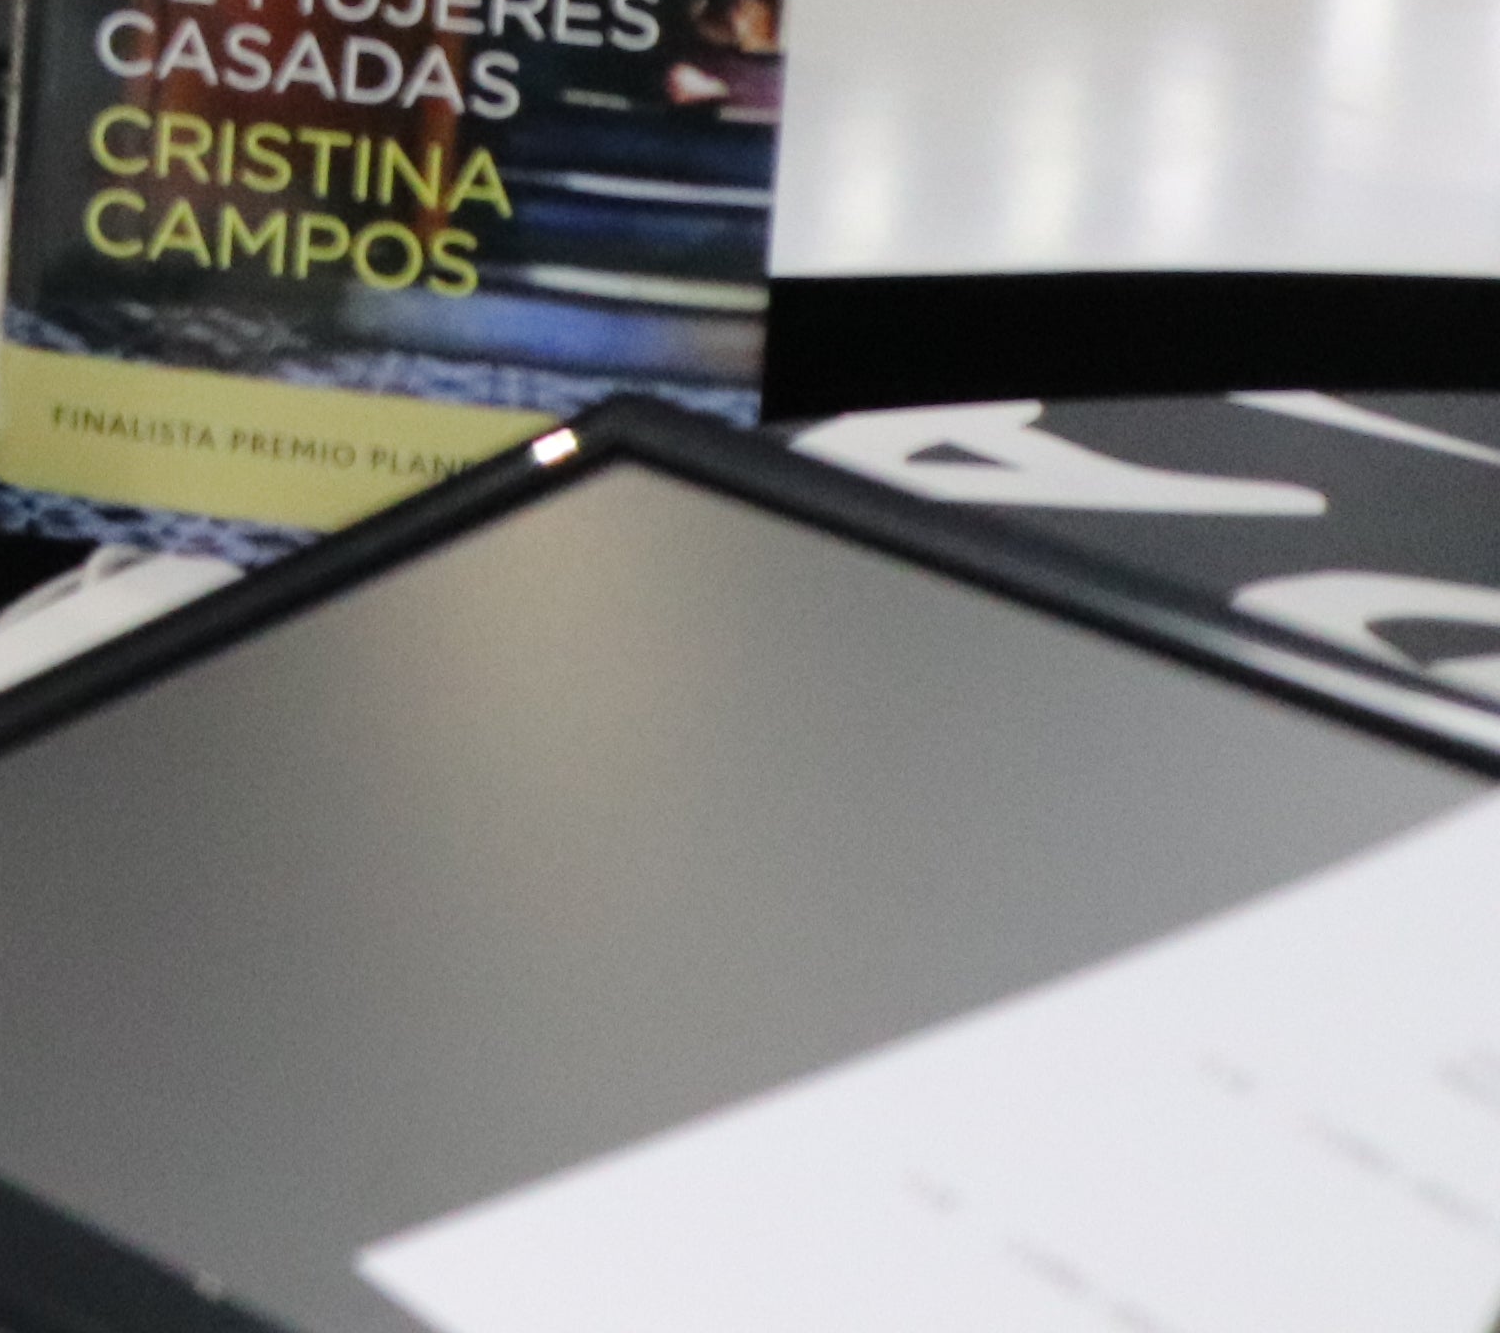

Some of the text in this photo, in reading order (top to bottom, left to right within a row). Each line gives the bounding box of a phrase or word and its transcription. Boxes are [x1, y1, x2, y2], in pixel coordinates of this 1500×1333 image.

[95, 9, 521, 121] CASADAS
[89, 105, 513, 220] CRISTINA
[83, 188, 479, 298] CAMPOS
[51, 403, 216, 452] FINALISTA
[229, 431, 358, 470] PREMIO
